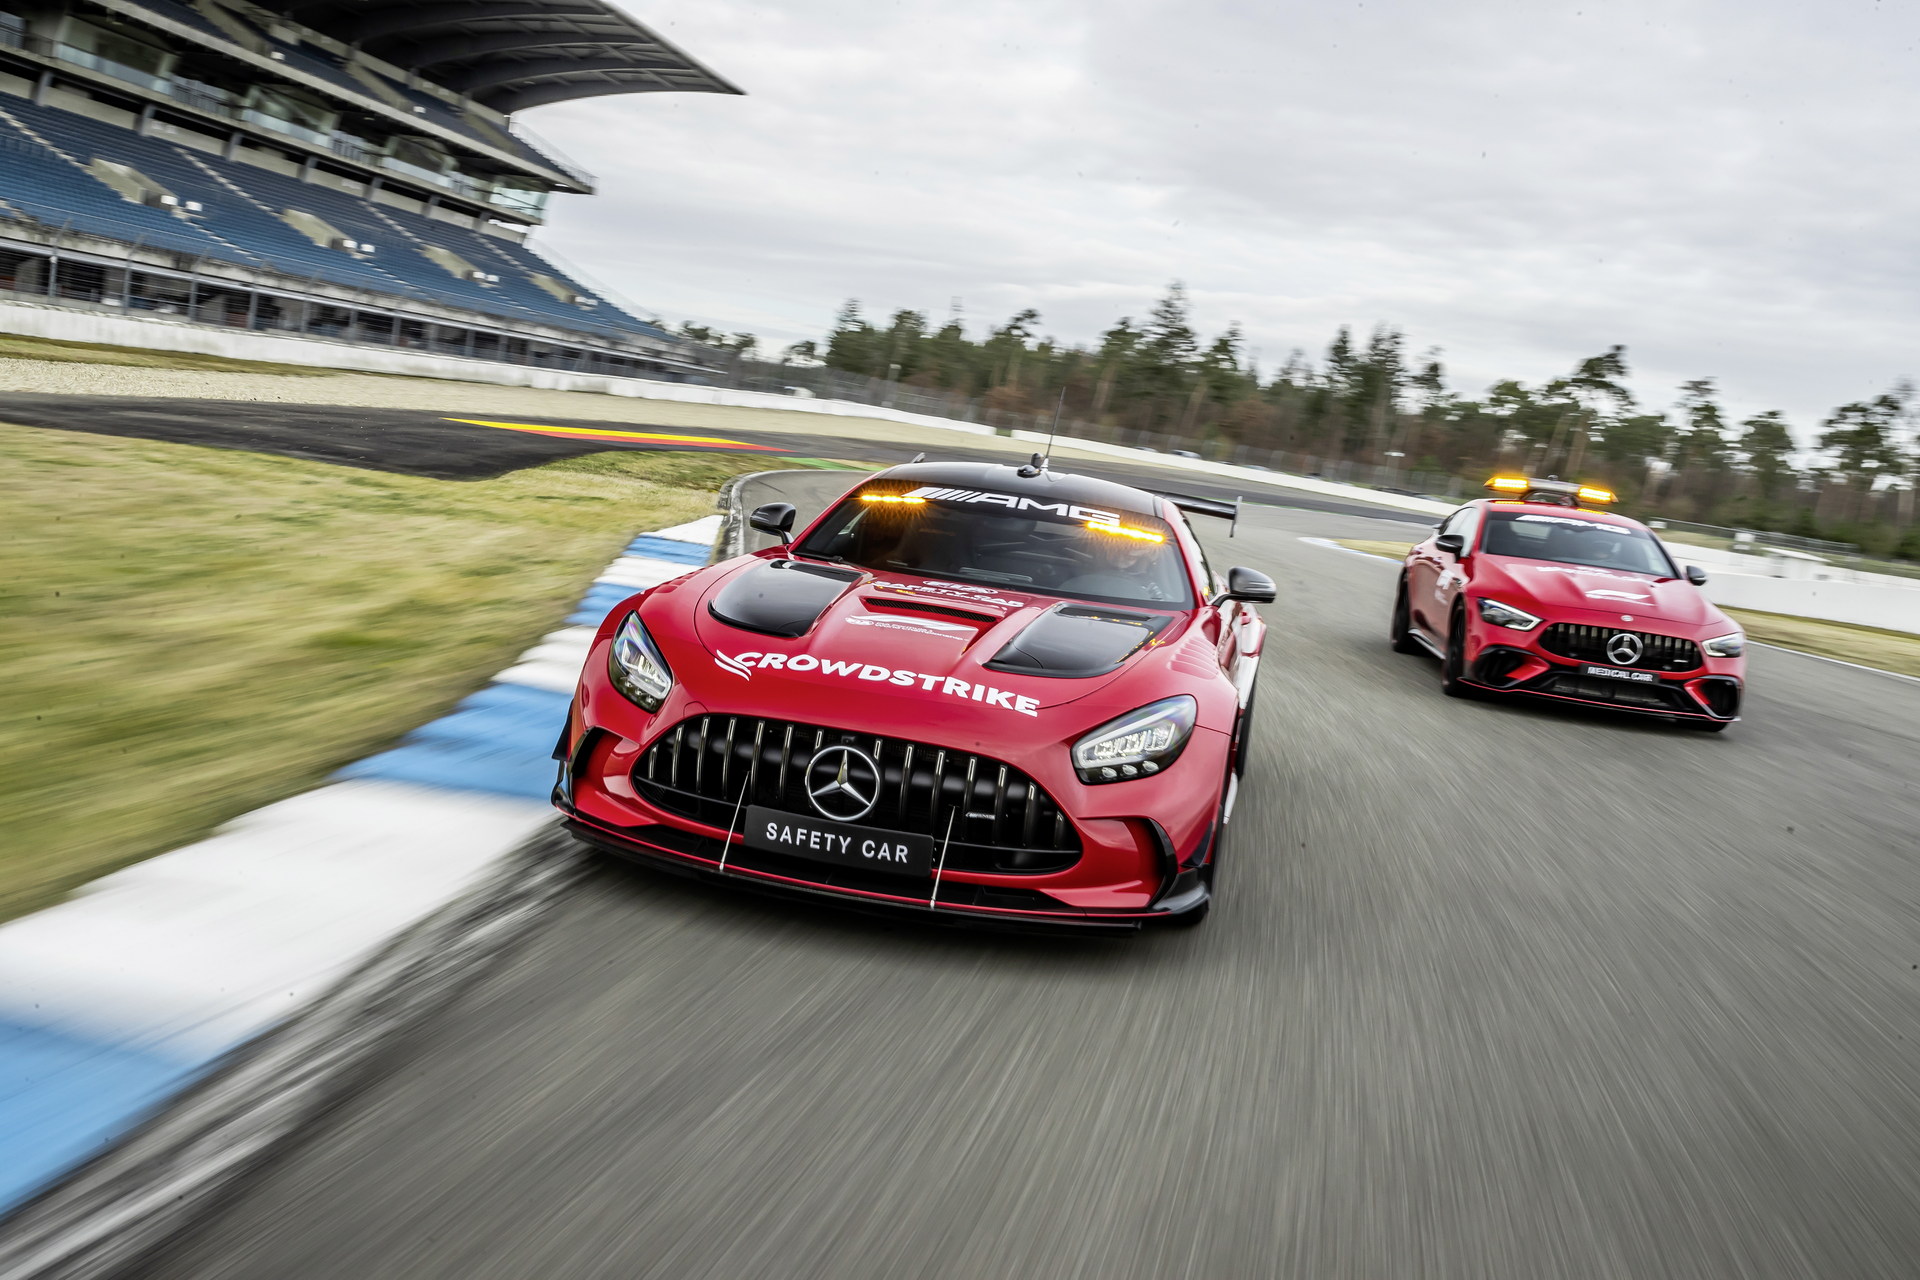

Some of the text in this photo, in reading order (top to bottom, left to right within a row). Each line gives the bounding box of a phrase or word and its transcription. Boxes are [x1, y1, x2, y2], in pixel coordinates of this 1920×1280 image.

[968, 490, 1121, 527] AMG
[734, 651, 1040, 717] CROWDSTRIKE
[1587, 666, 1653, 682] MEDICAL CAR
[766, 822, 908, 863] SAFETY CAR
